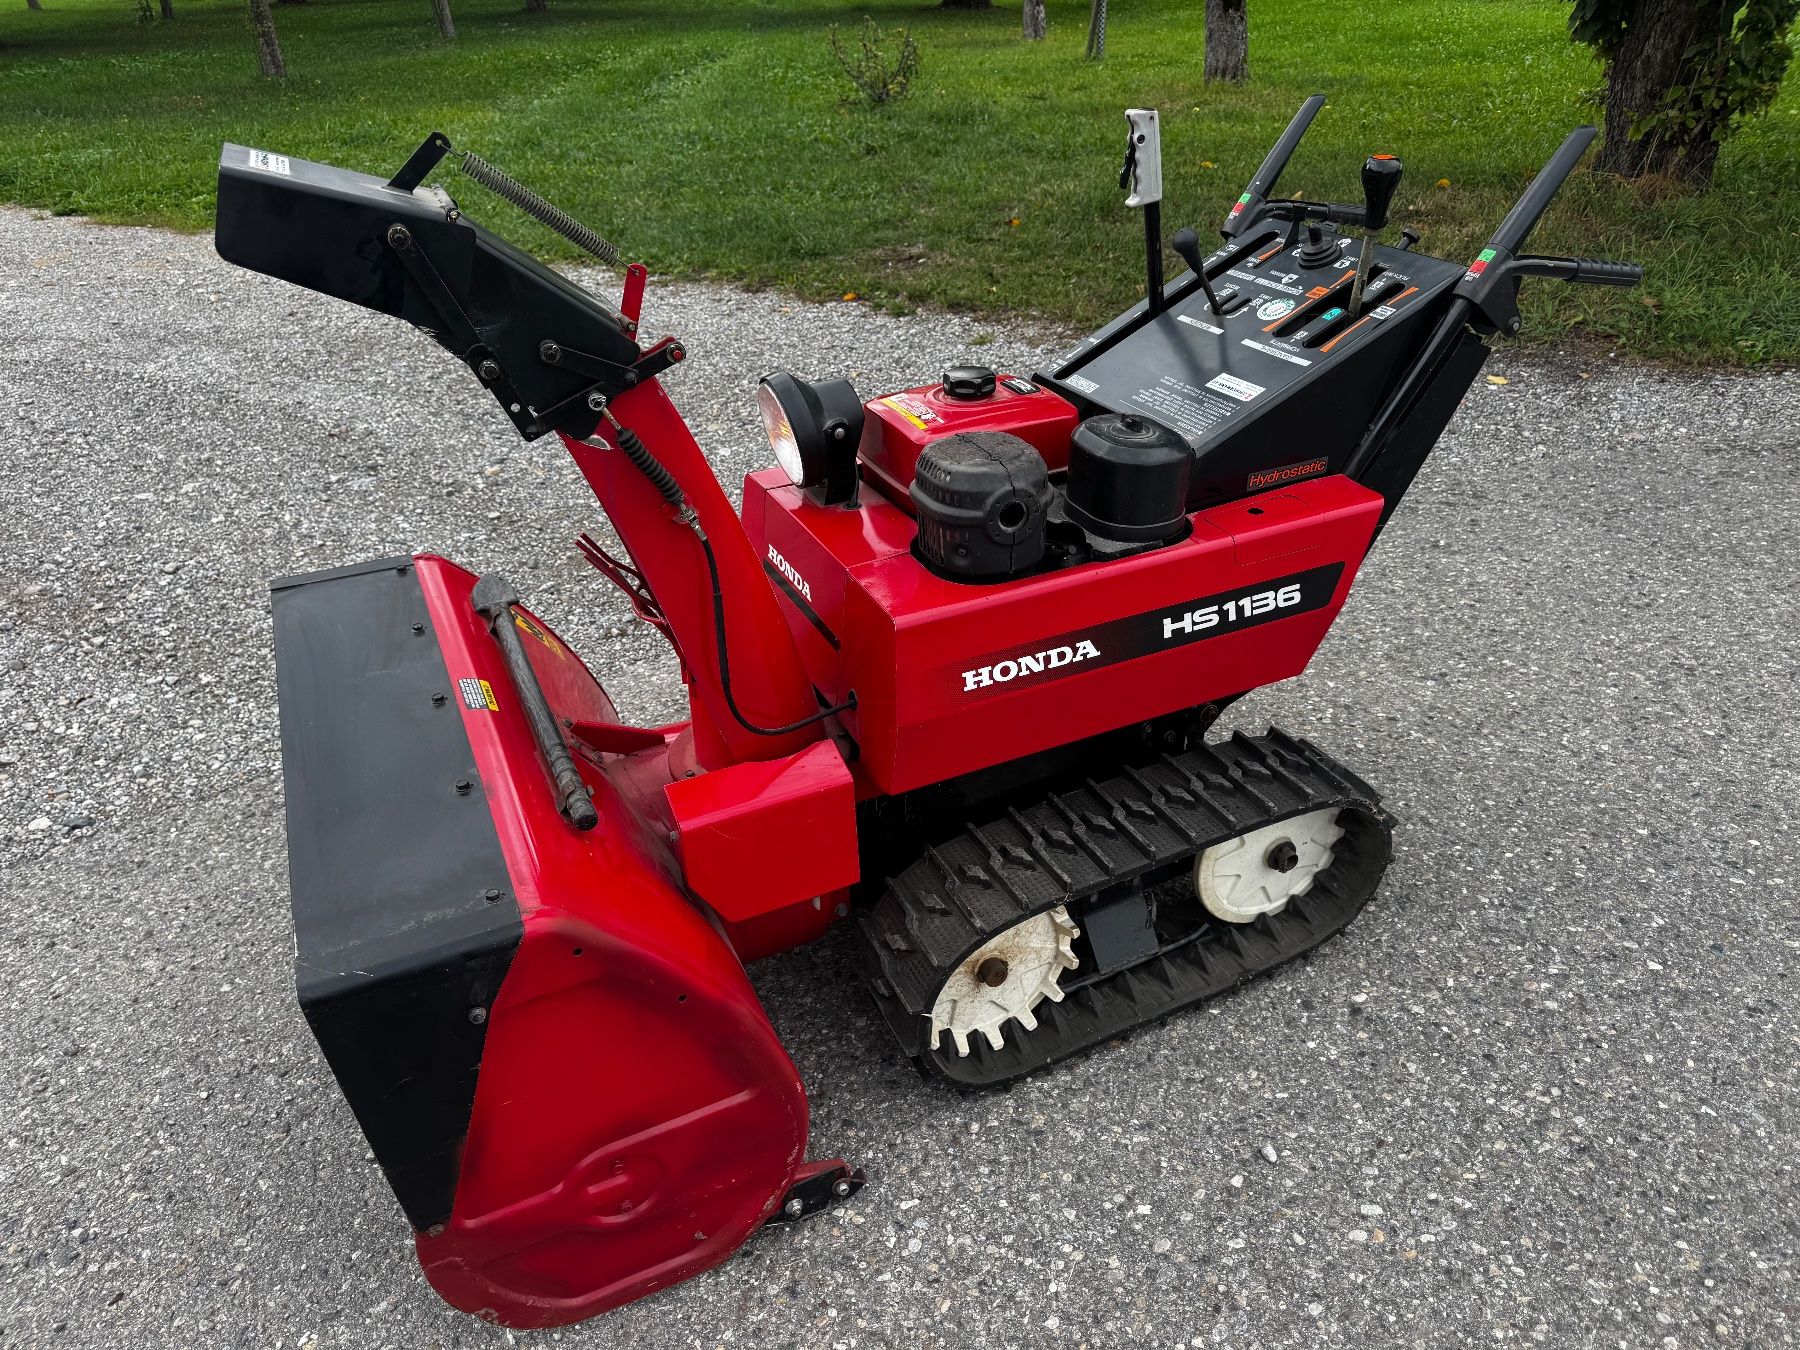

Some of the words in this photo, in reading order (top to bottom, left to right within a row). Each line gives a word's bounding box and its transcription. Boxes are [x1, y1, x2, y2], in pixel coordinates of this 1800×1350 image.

[1249, 460, 1326, 488] Hydrostatic
[767, 543, 812, 602] HONDA
[1163, 583, 1301, 639] HS1136
[962, 639, 1101, 692] HONDA
